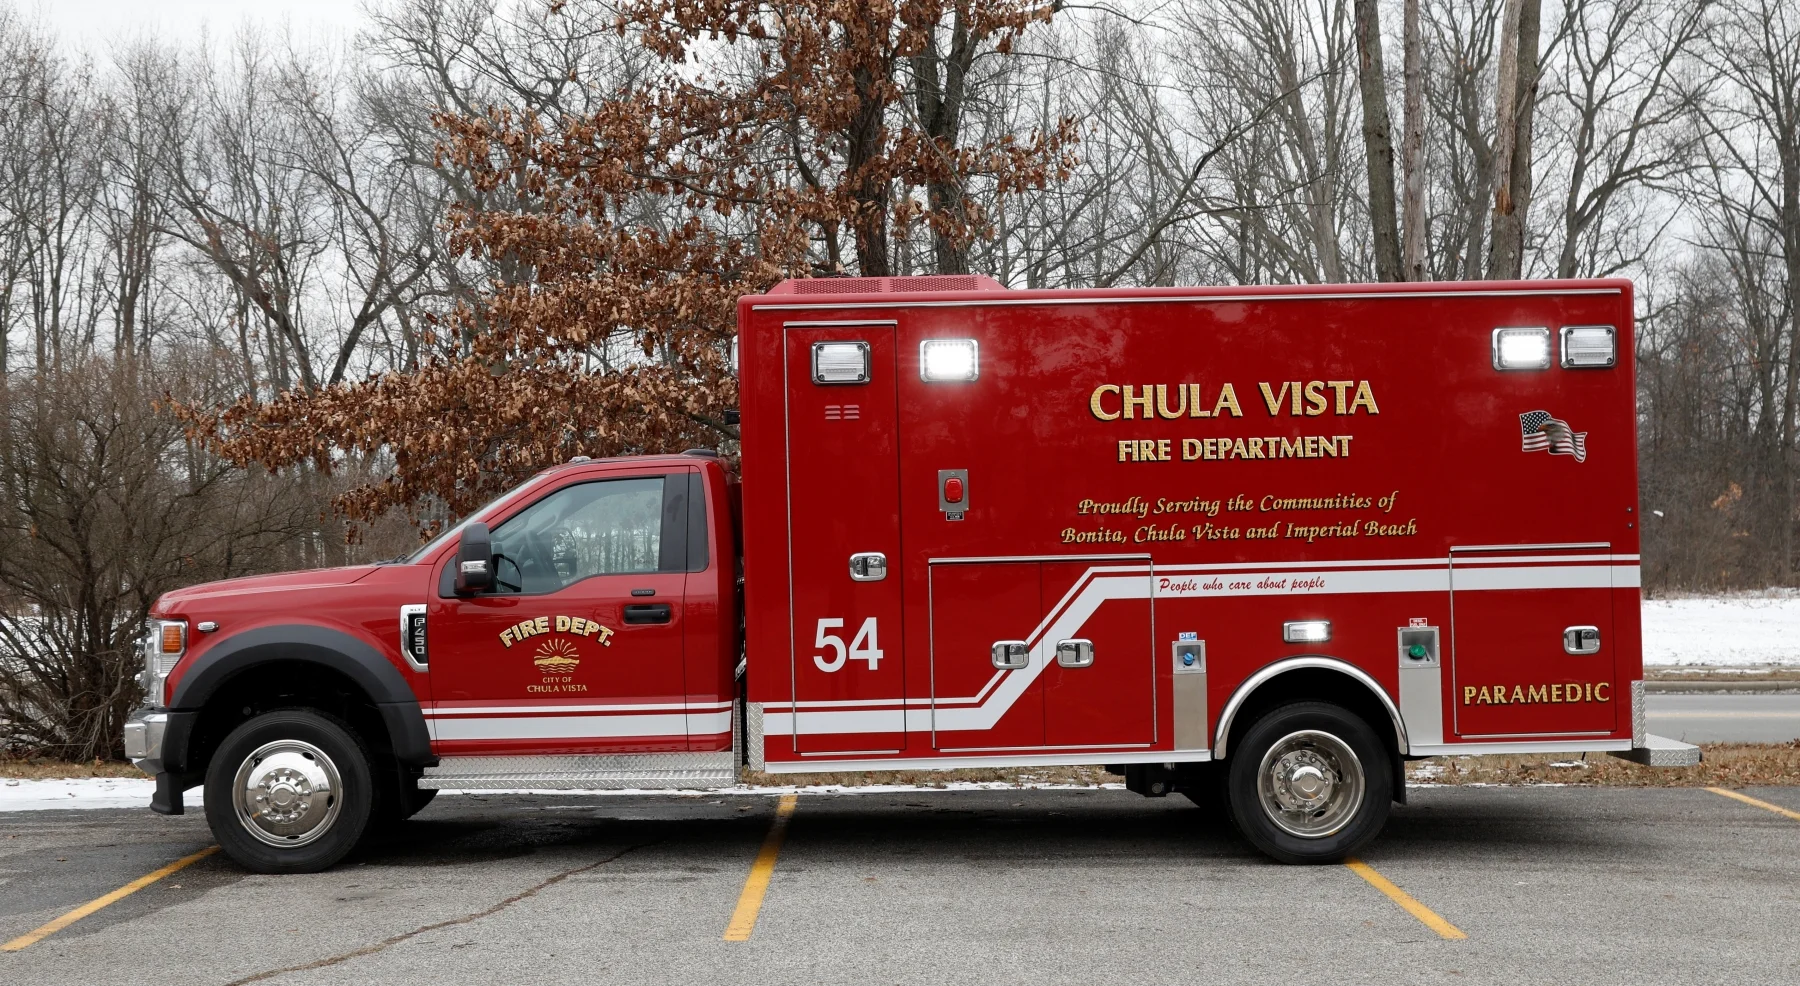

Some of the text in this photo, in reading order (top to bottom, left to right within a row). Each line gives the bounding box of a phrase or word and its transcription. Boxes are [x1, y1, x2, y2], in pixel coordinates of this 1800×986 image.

[1090, 380, 1379, 421] CHULA VISTA
[1118, 435, 1353, 462] FIRE DEPARTMENT
[1078, 490, 1399, 519] Proudly Serving the Communities of
[1061, 518, 1417, 544] Bonita, Chula Vista and Imperial Beach
[1159, 576, 1325, 594] People who care about people
[499, 615, 614, 648] FIRE DEPT.
[813, 616, 884, 673] 54
[527, 684, 588, 693] CHULA VISTA
[542, 676, 560, 684] CITY
[1464, 682, 1610, 705] PARAMEDIC
